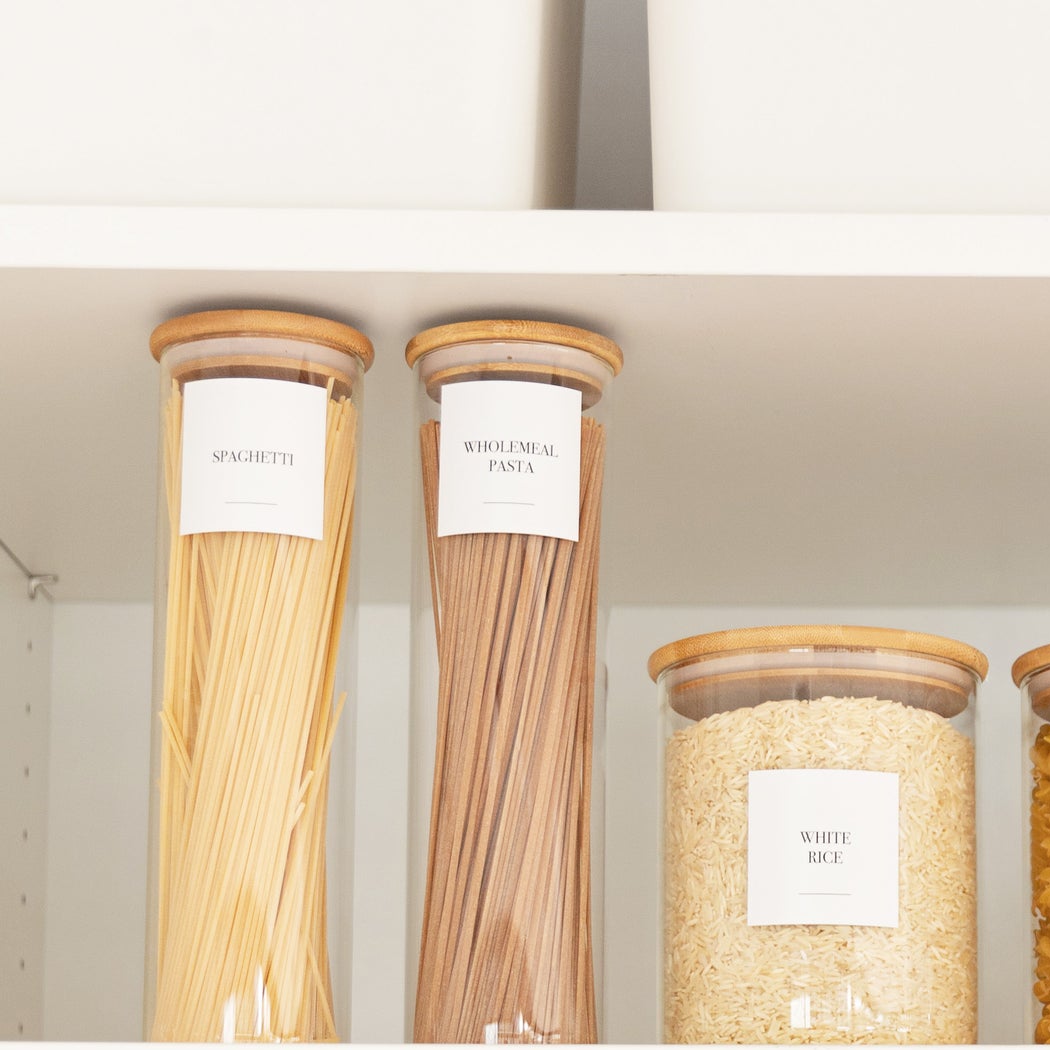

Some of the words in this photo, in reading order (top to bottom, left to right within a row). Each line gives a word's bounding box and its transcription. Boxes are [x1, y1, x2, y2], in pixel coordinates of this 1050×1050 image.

[464, 440, 559, 458] WHOLEMEAL
[212, 449, 294, 467] SPAGHETTI
[488, 459, 535, 474] PASTA
[800, 830, 852, 845] WHITE
[808, 850, 844, 865] RICE
